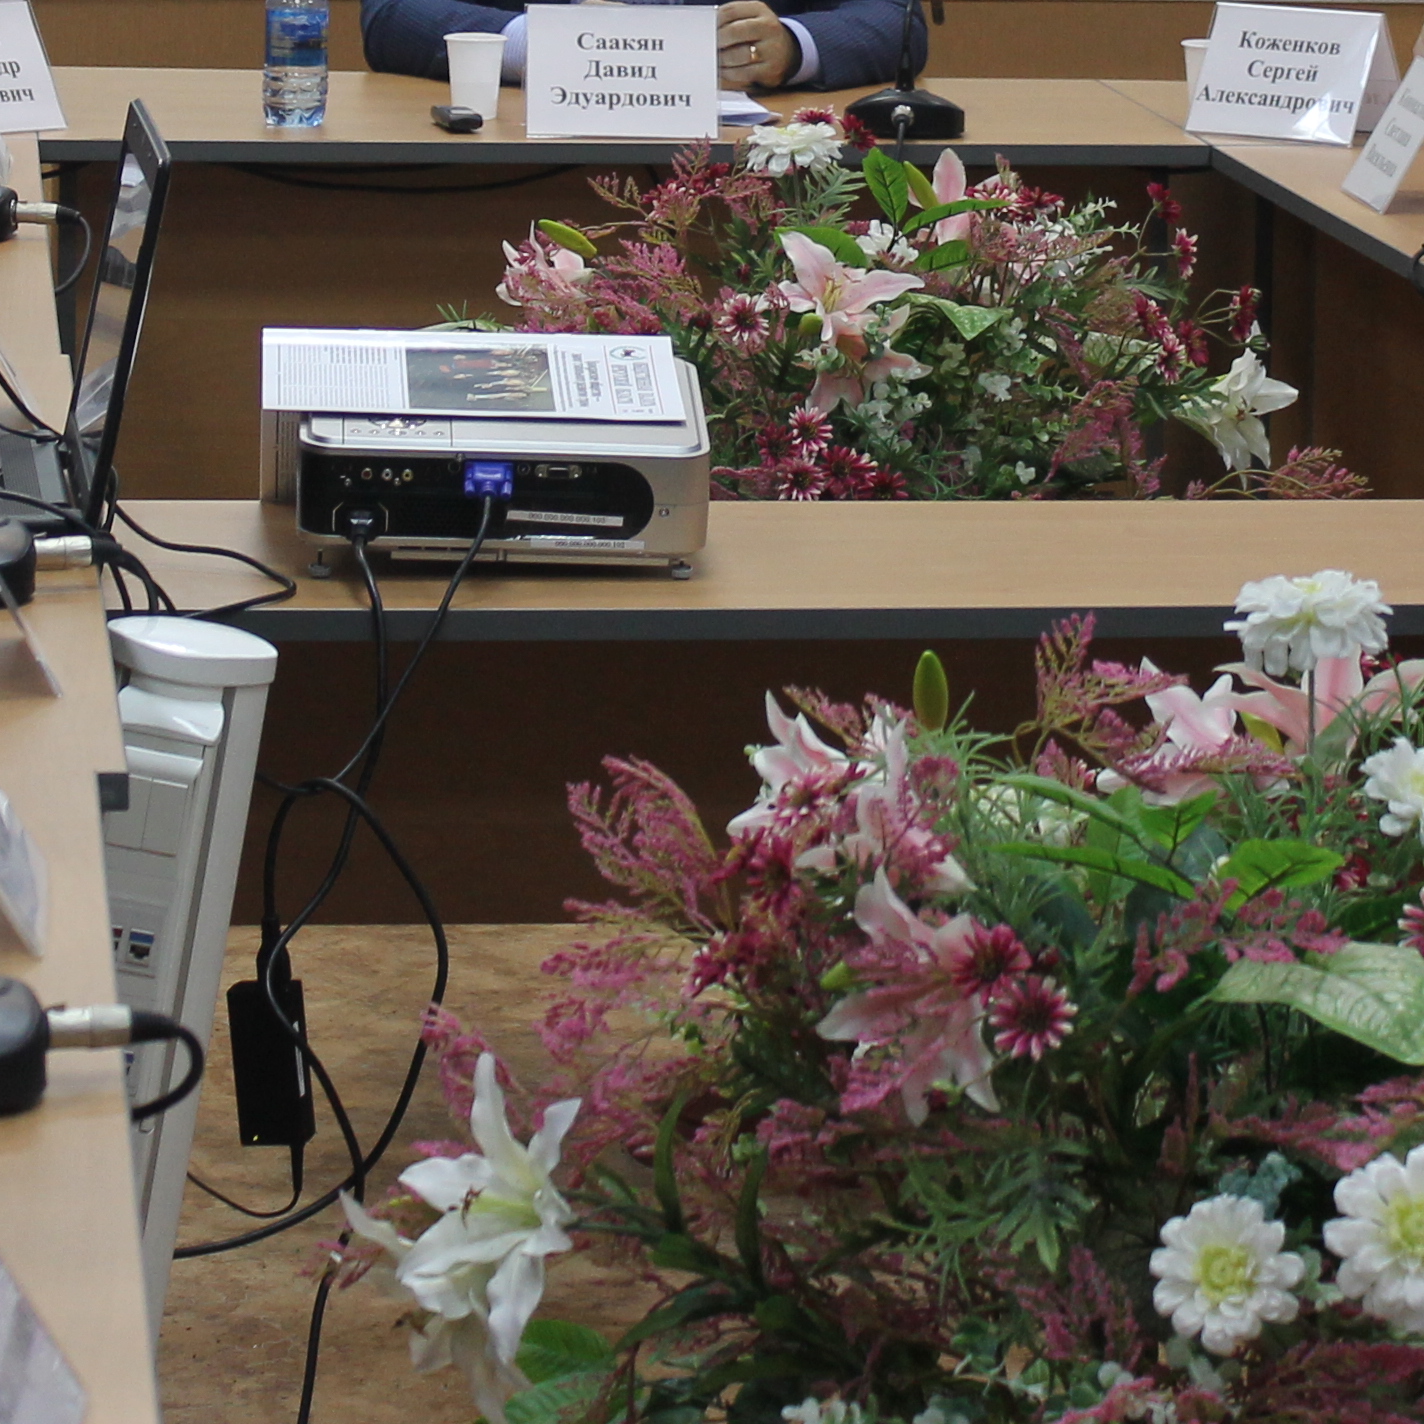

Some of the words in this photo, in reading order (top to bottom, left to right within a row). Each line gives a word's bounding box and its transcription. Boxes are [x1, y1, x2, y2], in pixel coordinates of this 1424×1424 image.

[576, 32, 665, 51] Саакян
[1238, 30, 1341, 56] Коженков
[583, 60, 657, 80] Давид
[1247, 59, 1319, 84] Сергей
[550, 87, 691, 111] Эдуардович
[1195, 83, 1355, 115] Александрович
